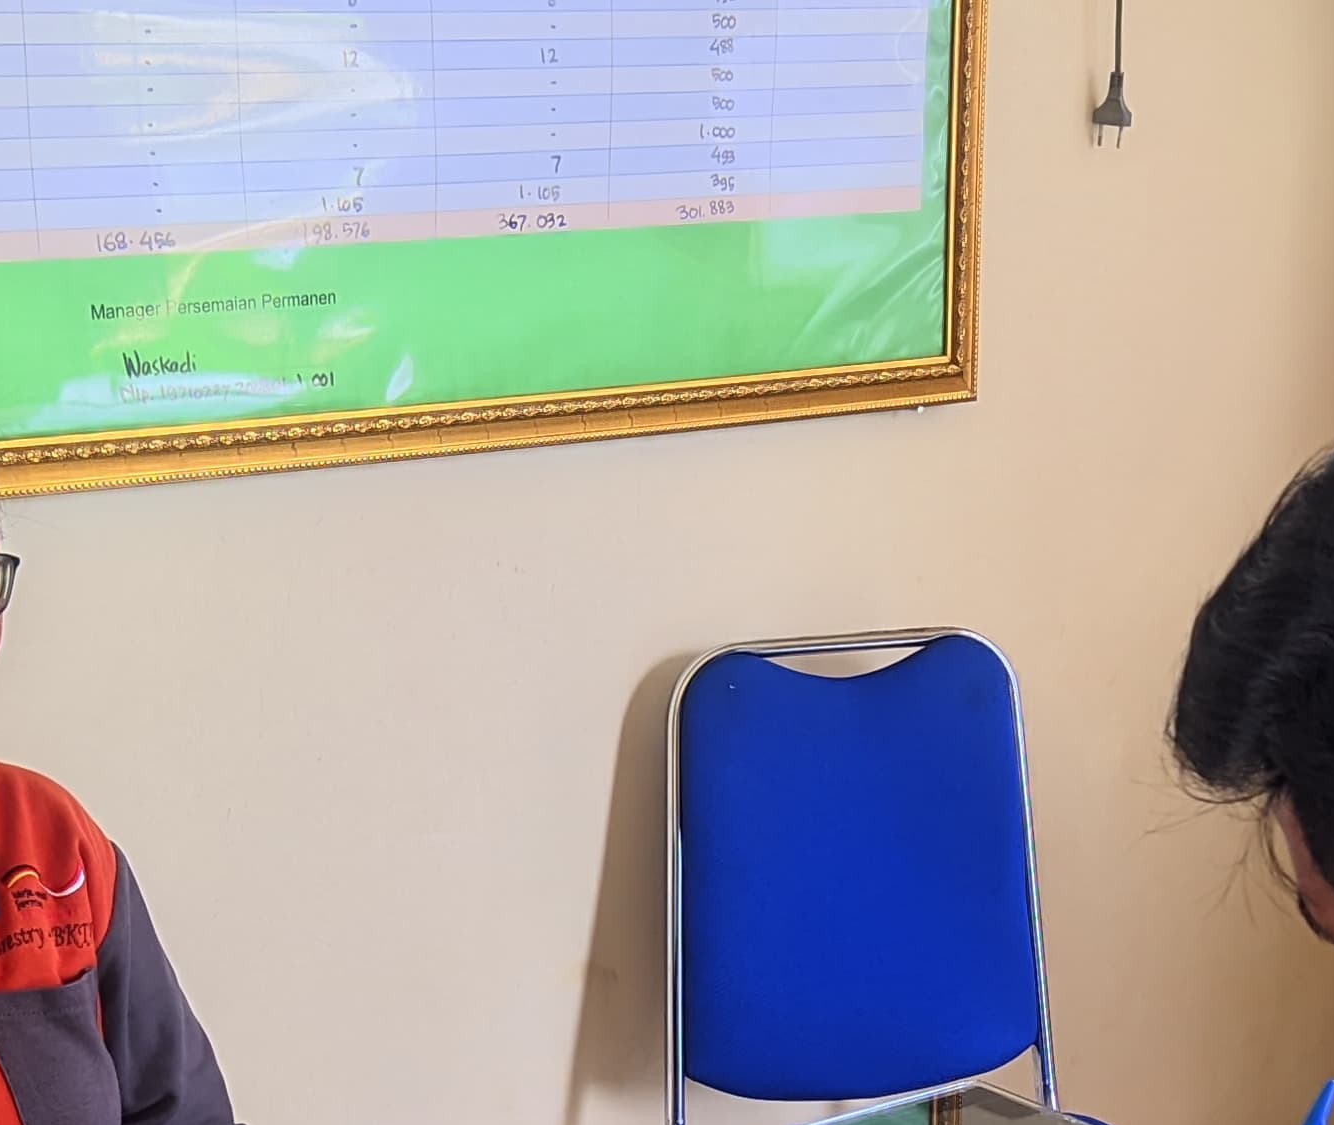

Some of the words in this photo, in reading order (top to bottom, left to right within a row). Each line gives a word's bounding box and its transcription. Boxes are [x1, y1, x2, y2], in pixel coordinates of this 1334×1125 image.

[711, 12, 737, 30] 500
[540, 47, 560, 65] 12
[711, 67, 735, 83] 500
[699, 123, 737, 140] 1.000
[550, 154, 562, 174] 7
[90, 302, 161, 321] Manager
[166, 294, 258, 316] Persemaian
[261, 290, 337, 310] Permanen
[122, 350, 197, 380] Waskadi
